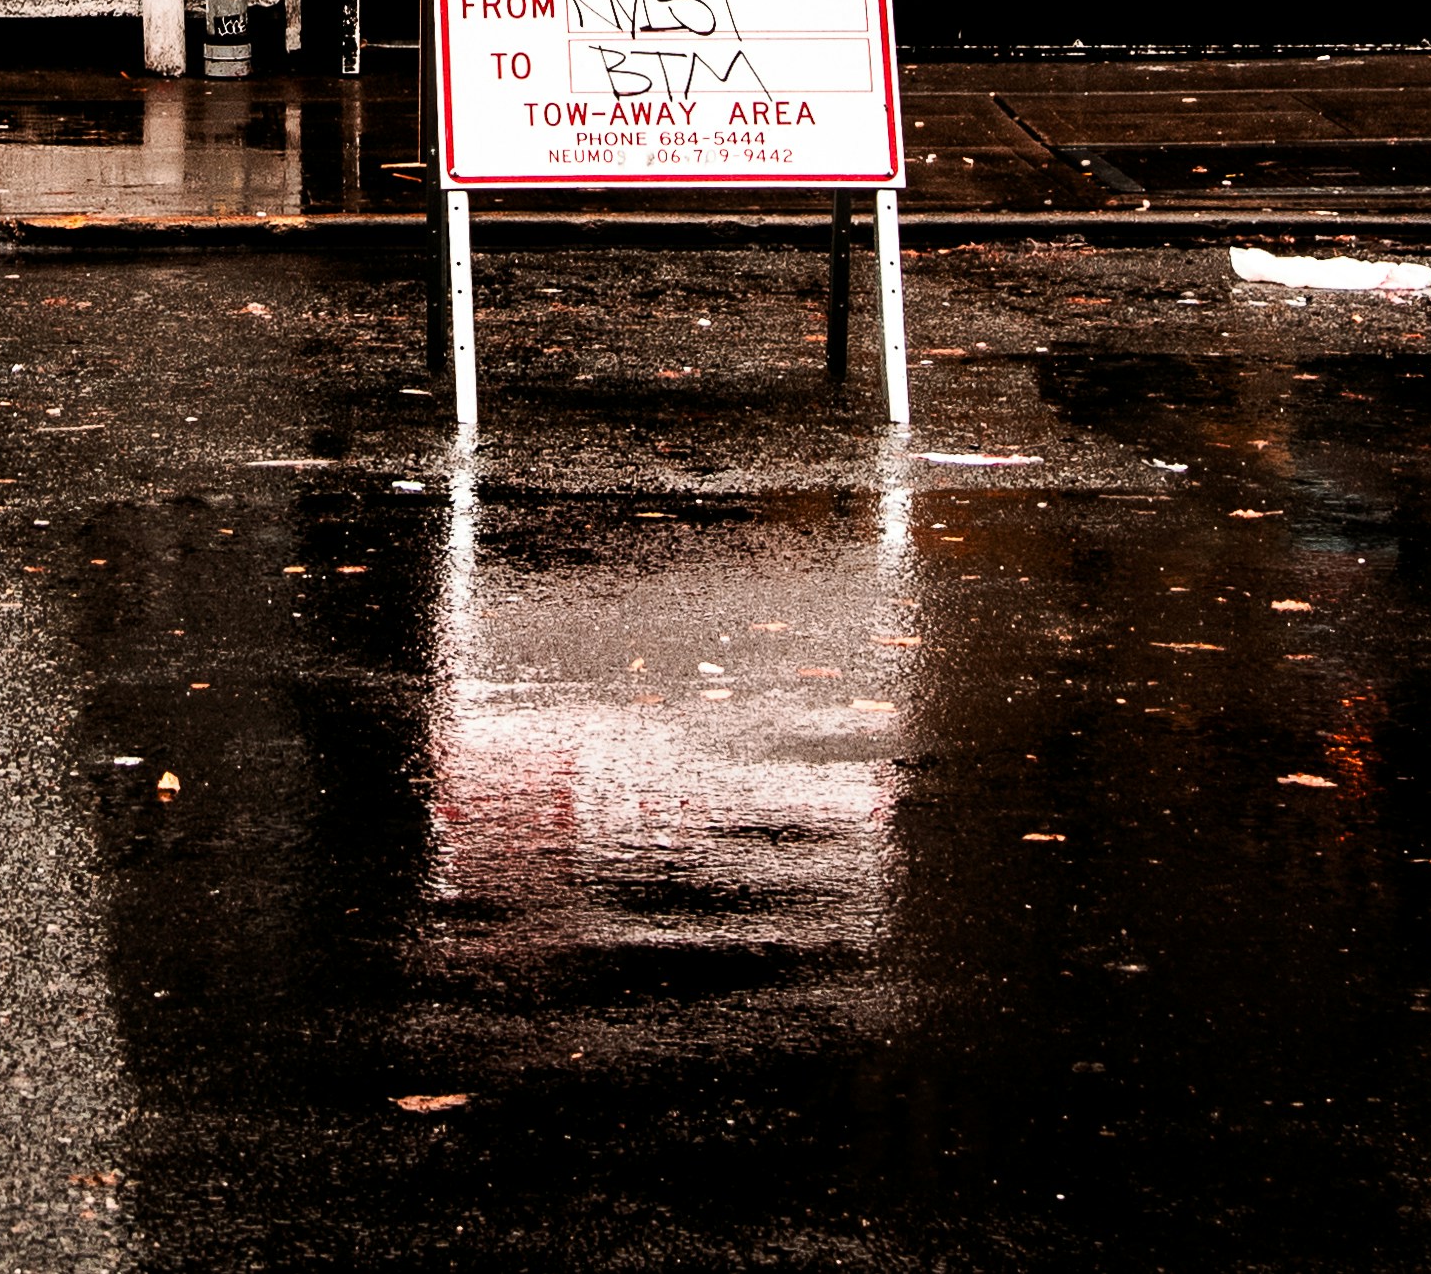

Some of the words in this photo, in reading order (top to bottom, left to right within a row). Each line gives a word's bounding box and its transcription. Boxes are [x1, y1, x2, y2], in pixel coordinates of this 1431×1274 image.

[490, 53, 532, 80] TO
[524, 101, 698, 127] TOW-AWAY
[729, 101, 817, 126] AREA
[576, 131, 648, 147] PHONE
[659, 131, 766, 147] 684-5444
